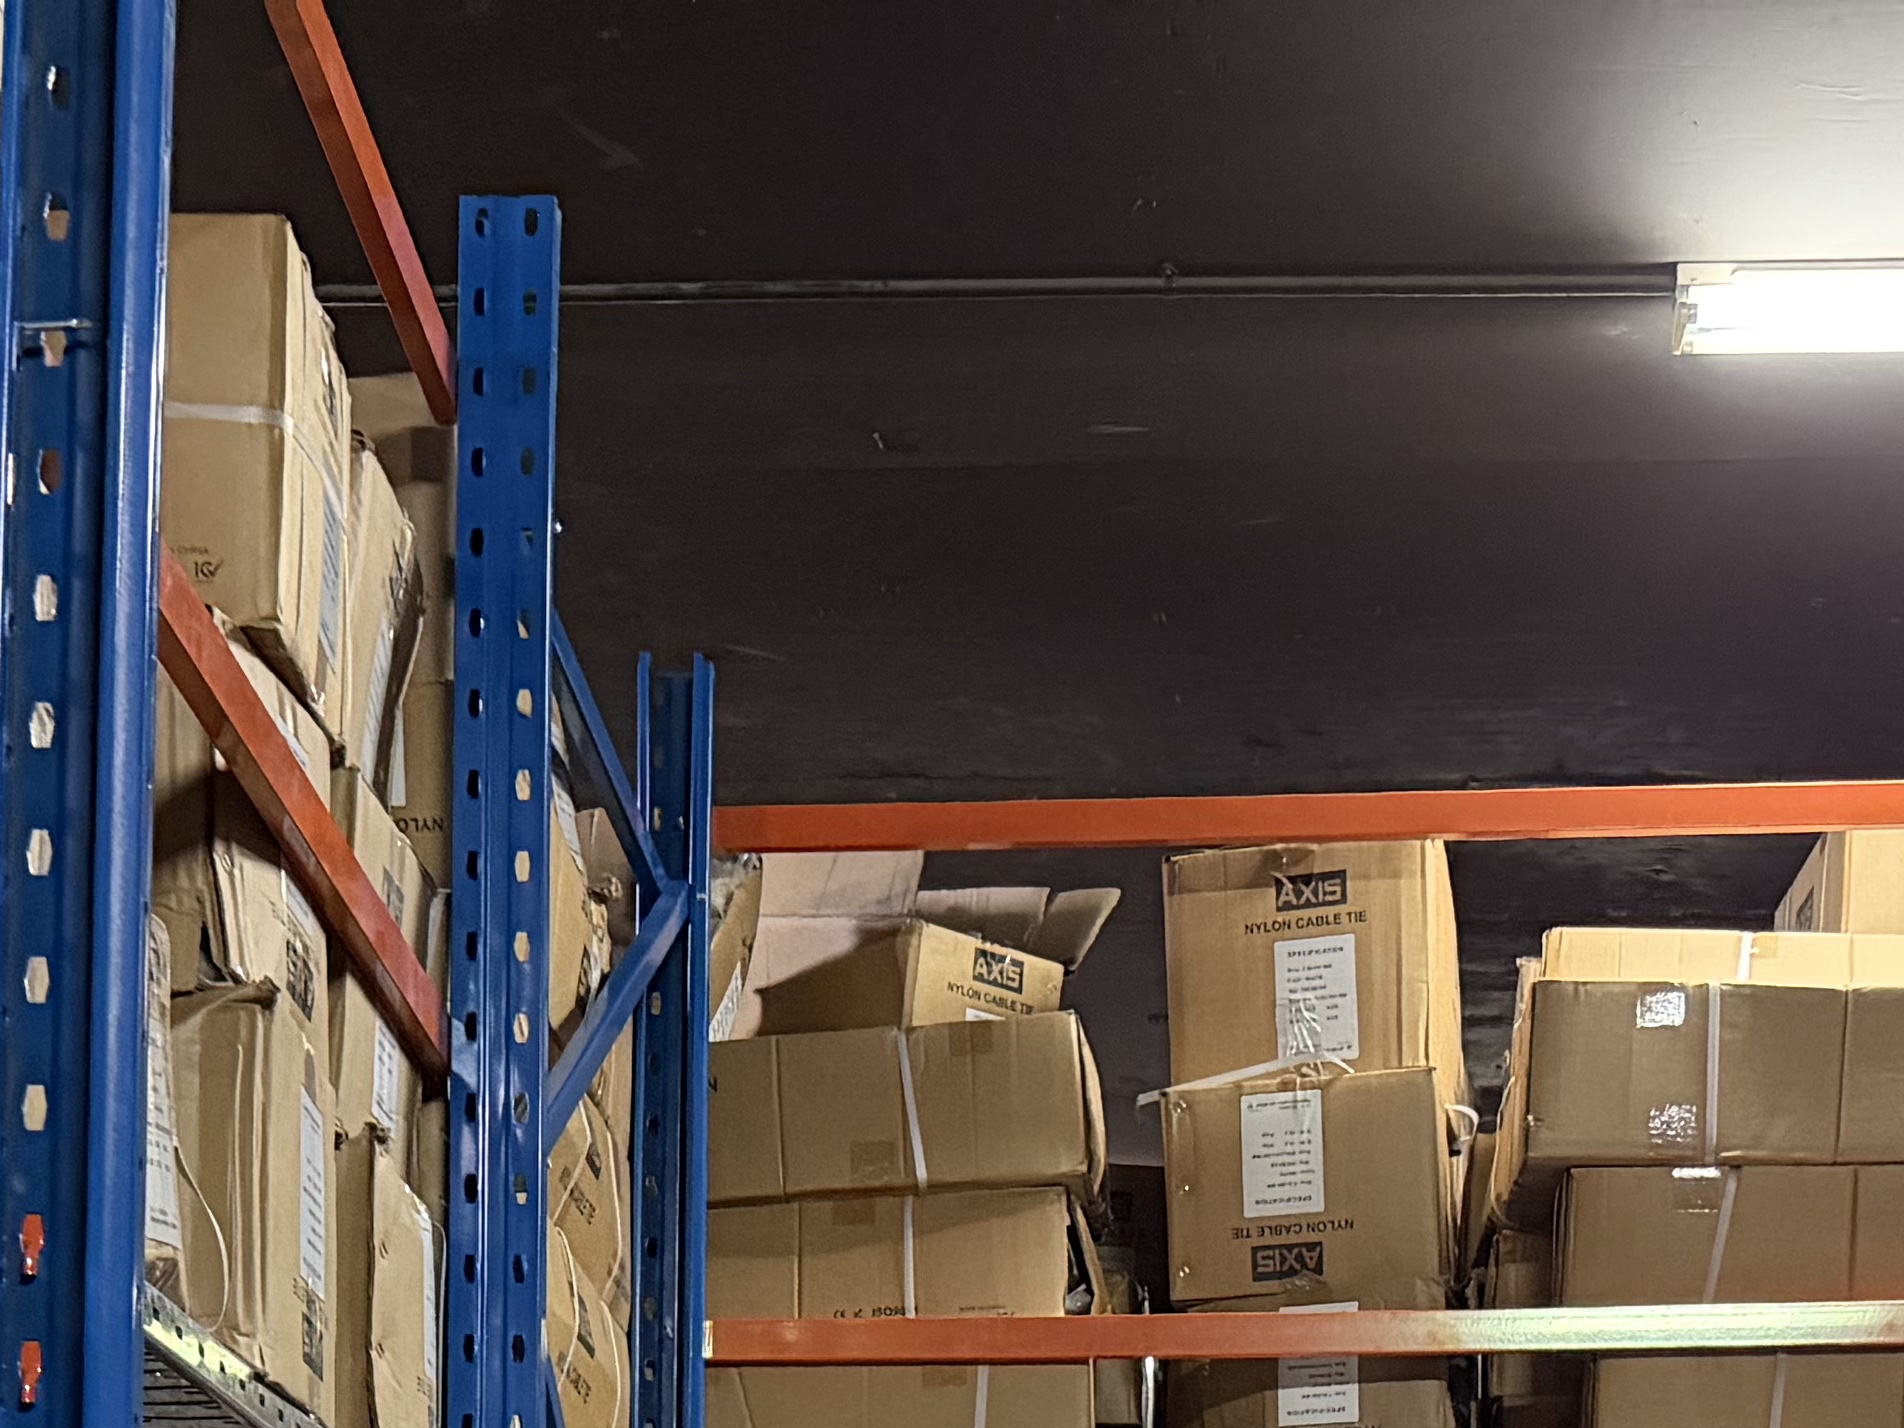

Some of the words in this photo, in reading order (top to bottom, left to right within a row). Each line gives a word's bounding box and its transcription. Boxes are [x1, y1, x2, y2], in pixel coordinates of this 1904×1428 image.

[1277, 878, 1342, 908] AXIS
[1244, 918, 1292, 936] NYLON
[1296, 913, 1342, 930] CABLE
[1346, 910, 1368, 923] TIE
[974, 954, 1022, 989] AXIS
[946, 981, 982, 1002] NYLON
[983, 992, 1017, 1012] CABLE
[1231, 1227, 1253, 1240] TIE
[1256, 1223, 1303, 1239] CABLE
[1306, 1218, 1355, 1234] NYLON
[1256, 1245, 1322, 1273] AXIS
